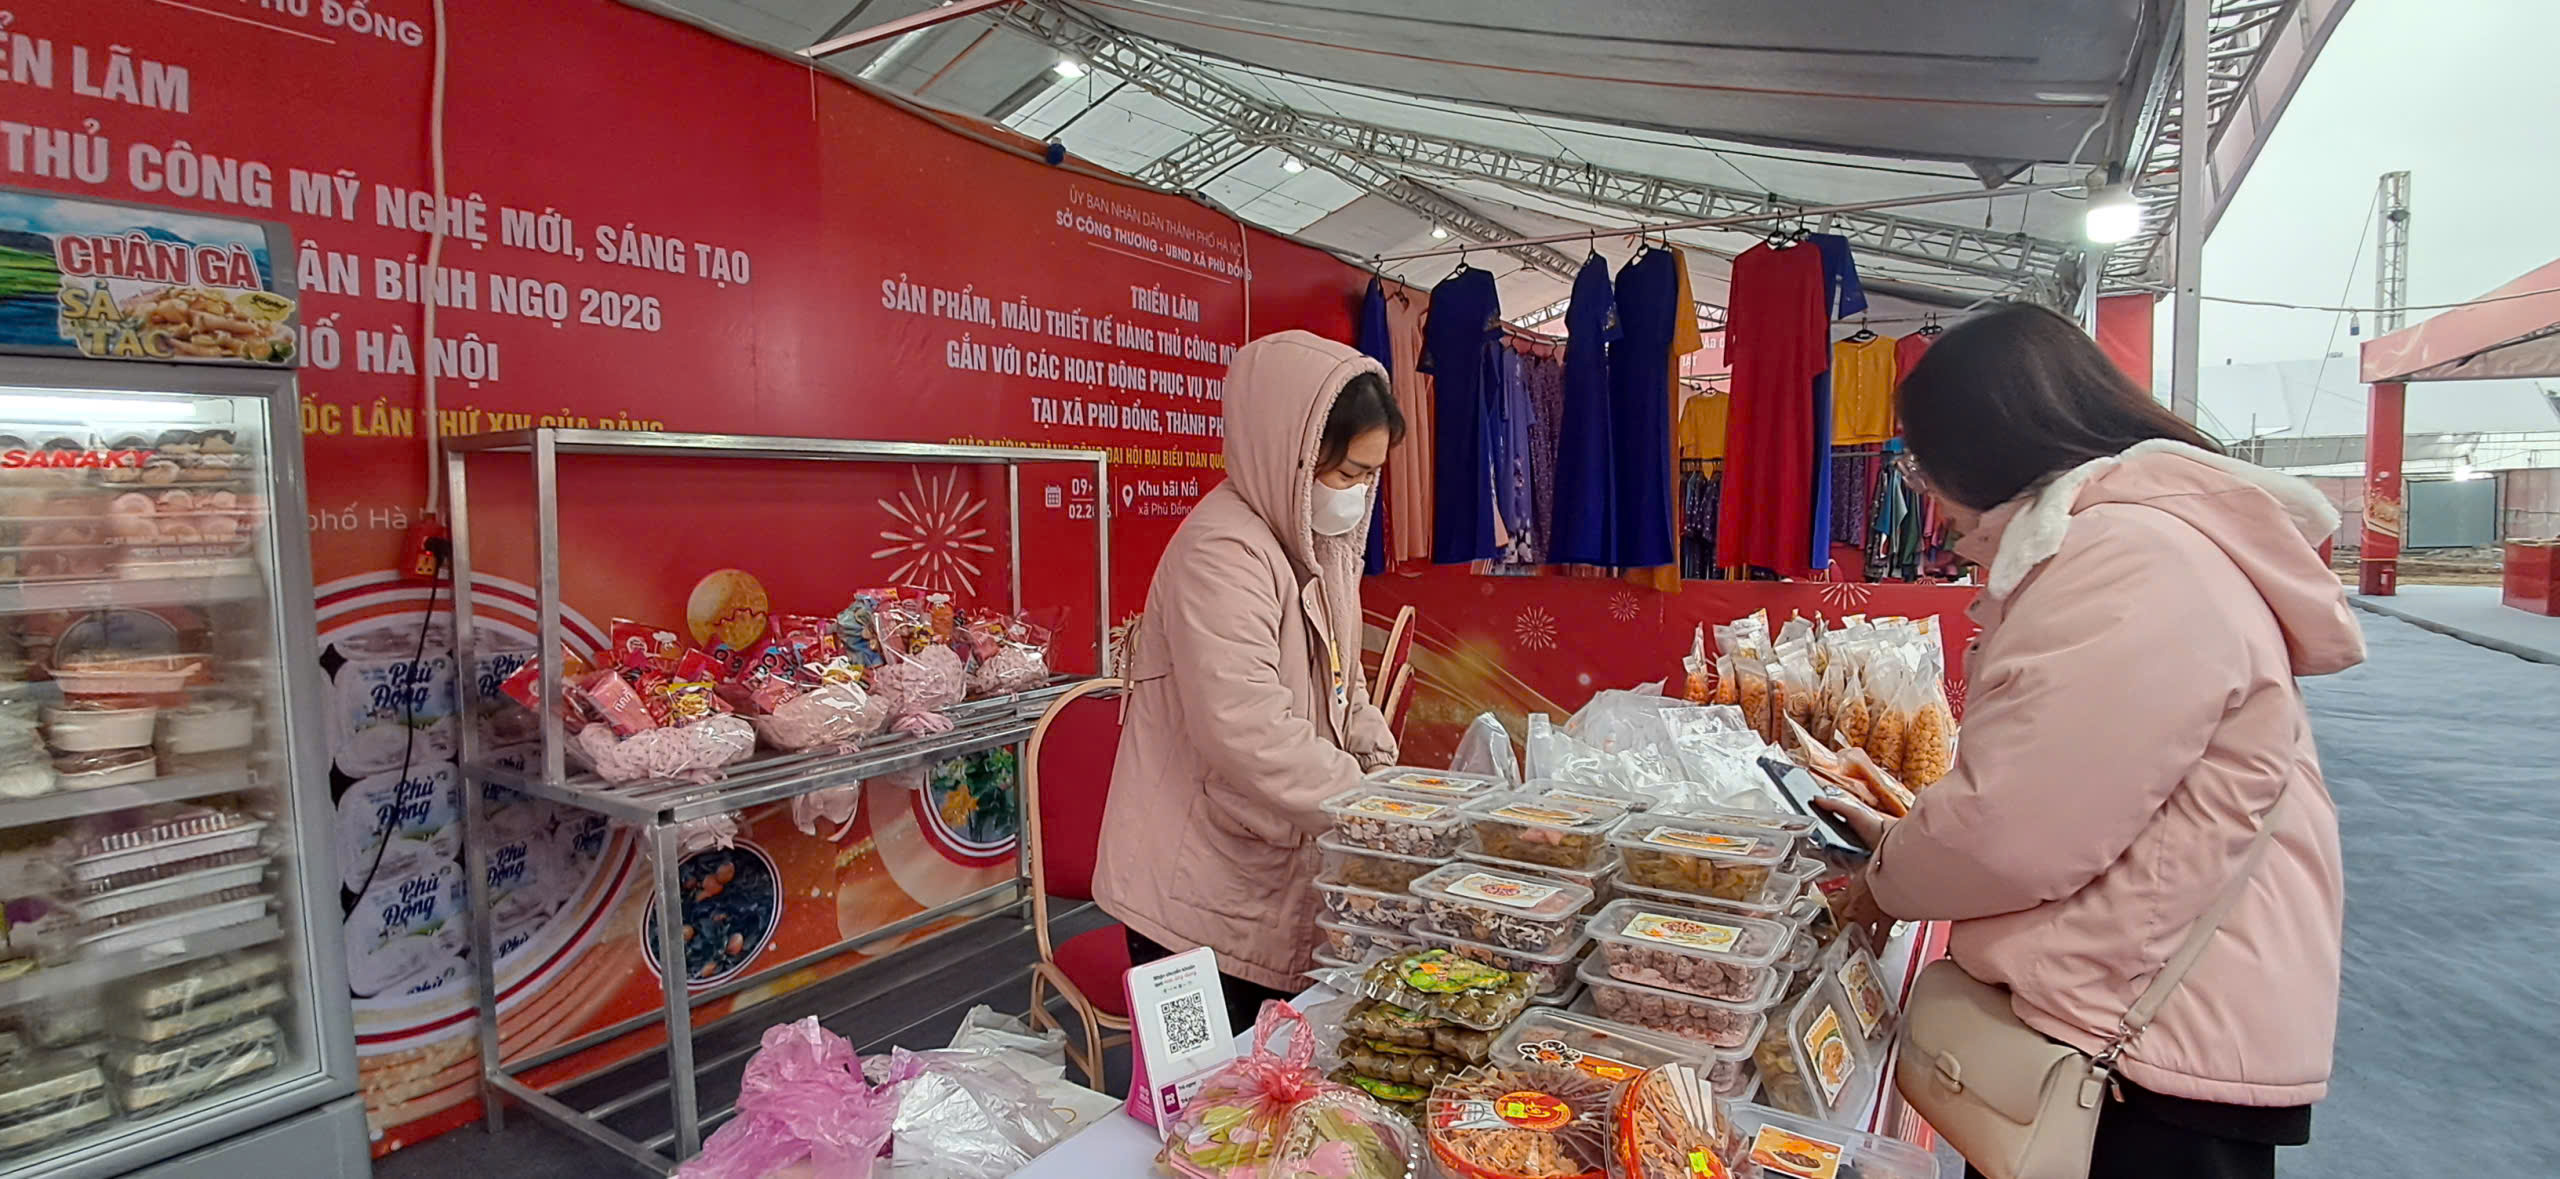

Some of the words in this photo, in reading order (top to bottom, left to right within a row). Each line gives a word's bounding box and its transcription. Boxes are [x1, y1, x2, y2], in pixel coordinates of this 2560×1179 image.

[72, 44, 190, 114] LÃM
[0, 118, 109, 184] THỦ
[128, 139, 273, 209] CÔNG
[289, 168, 361, 221] MỸ
[375, 184, 488, 250] NGHỆ
[501, 206, 585, 263] MỚI,
[596, 222, 686, 274] SÁNG
[694, 242, 751, 289] TẠO
[1086, 193, 1110, 215] BAN
[1142, 210, 1165, 232] DÂN
[1230, 241, 1243, 258] NỘ
[59, 232, 189, 286] CHÂN
[198, 243, 261, 290] GÀ
[1056, 207, 1073, 228] SỞ
[1075, 215, 1113, 240] CÔNG
[1113, 226, 1159, 253] THƯƠNG
[1165, 243, 1192, 265] UBND
[1192, 250, 1207, 269] XÃ
[1207, 256, 1227, 274] PHÙ
[298, 239, 361, 297] ÂN
[375, 253, 477, 311] BÍNH
[490, 273, 568, 328] NGỌ
[579, 287, 662, 332] 2026
[1130, 282, 1170, 317] TRIỂN
[1171, 293, 1200, 323] LÃM
[881, 272, 928, 315] SẢN
[932, 283, 997, 330] PHẨM,
[1000, 295, 1042, 334] MẪU
[1045, 307, 1090, 342] THIẾT
[1093, 314, 1114, 345] KẾ
[1116, 320, 1154, 353] HÀNG
[1157, 327, 1182, 358] THỦ
[1184, 333, 1218, 364] CÔNG
[355, 323, 417, 376] HÀ
[431, 332, 500, 389] NỘI
[991, 342, 1022, 377] VỚI
[1026, 347, 1061, 381] CÁC
[1064, 355, 1105, 390] HOẠT
[1107, 359, 1147, 394] ĐỘNG
[1149, 368, 1185, 400] PHỤC
[1187, 374, 1204, 403] VỤ
[302, 392, 343, 436] ỐC
[352, 396, 416, 438] LẦN
[422, 405, 481, 438] HỨ
[1031, 396, 1058, 430] TẠI
[1061, 396, 1085, 427] XÃ
[1087, 400, 1119, 430] PHÙ
[1166, 408, 1207, 438] THÀNH
[1208, 415, 1225, 439] PH
[0, 449, 156, 469] SANAKY
[1126, 444, 1143, 469] HỘI
[1144, 448, 1161, 469] ĐẠI
[1185, 448, 1208, 469] TOÀN
[1072, 478, 1088, 496] 09
[1137, 480, 1160, 497] Khu
[1162, 480, 1179, 497] bãi
[1138, 503, 1149, 516] xã
[370, 504, 408, 530] Hà
